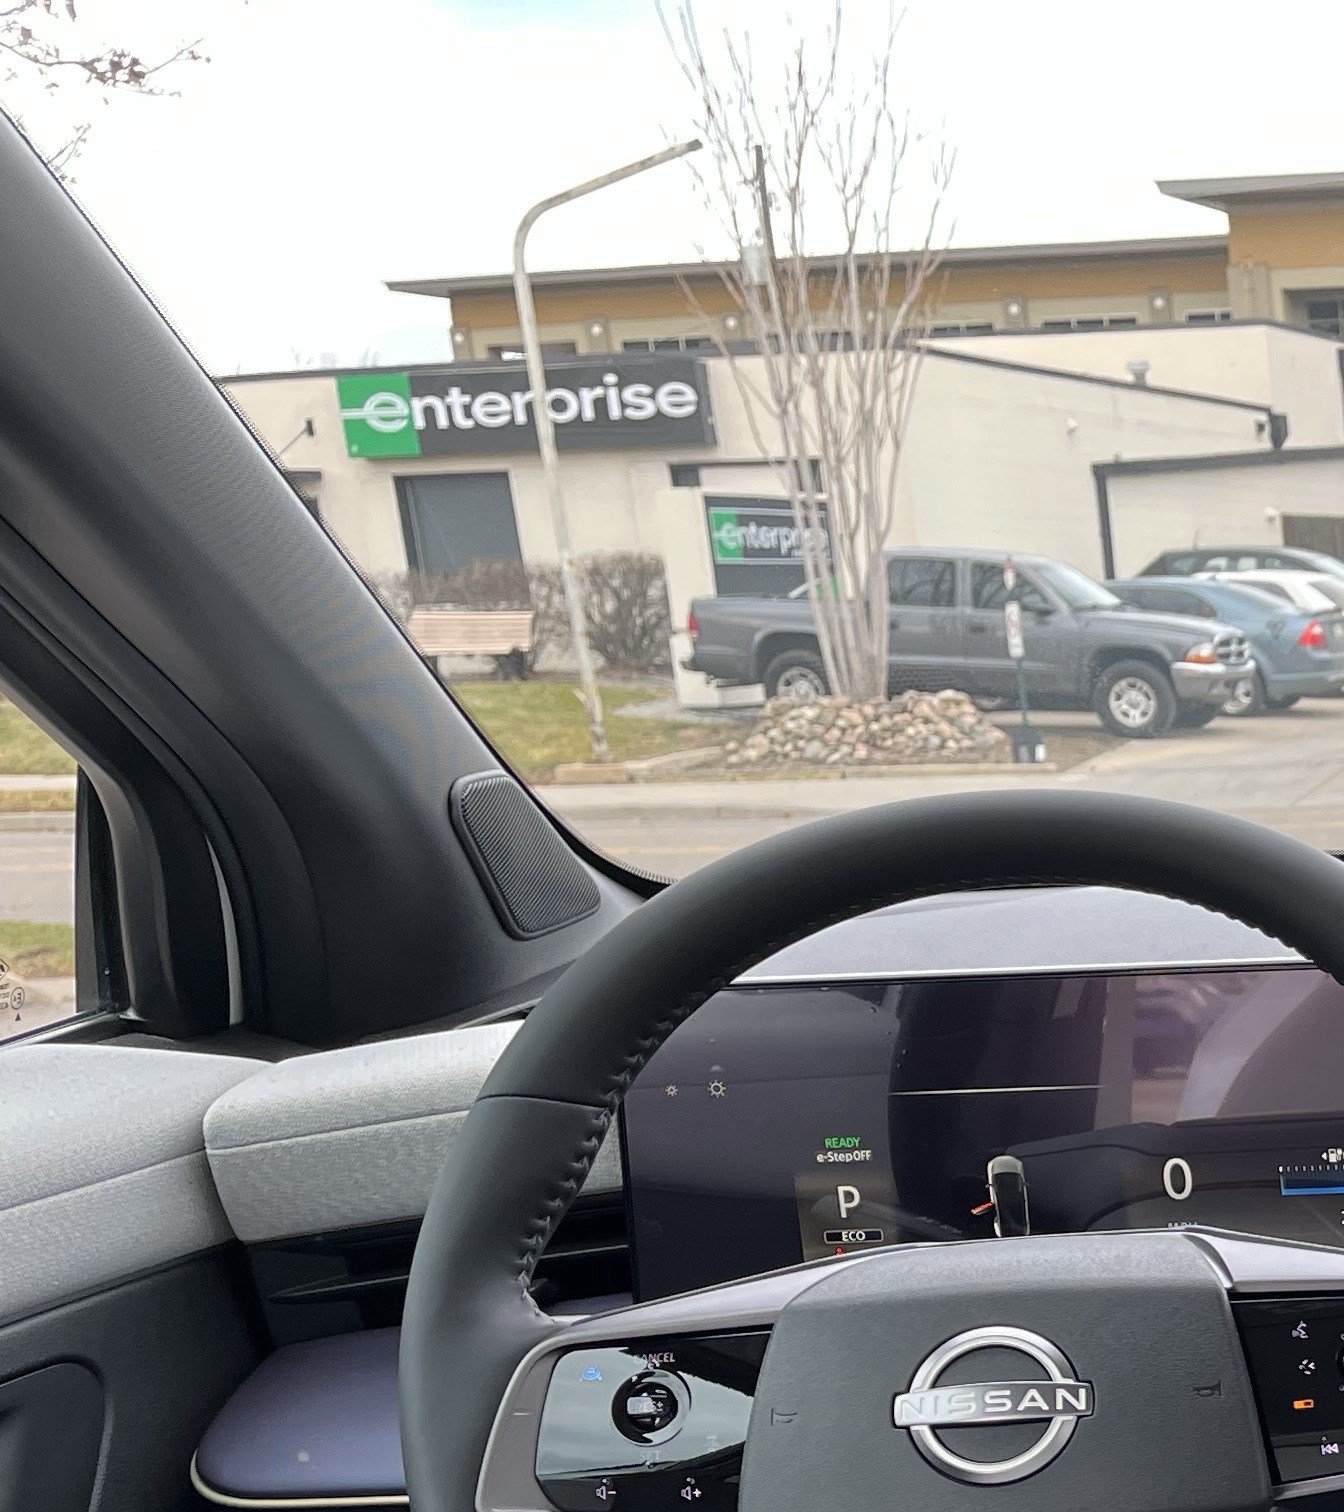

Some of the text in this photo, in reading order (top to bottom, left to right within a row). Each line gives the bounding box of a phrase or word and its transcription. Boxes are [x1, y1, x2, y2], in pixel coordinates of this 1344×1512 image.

[825, 1137, 861, 1149] READY
[1162, 1157, 1193, 1200] 0
[837, 1185, 860, 1218] P
[842, 1231, 866, 1241] ECO
[633, 1352, 675, 1364] ANCEL
[900, 1388, 1086, 1421] NISSAN
